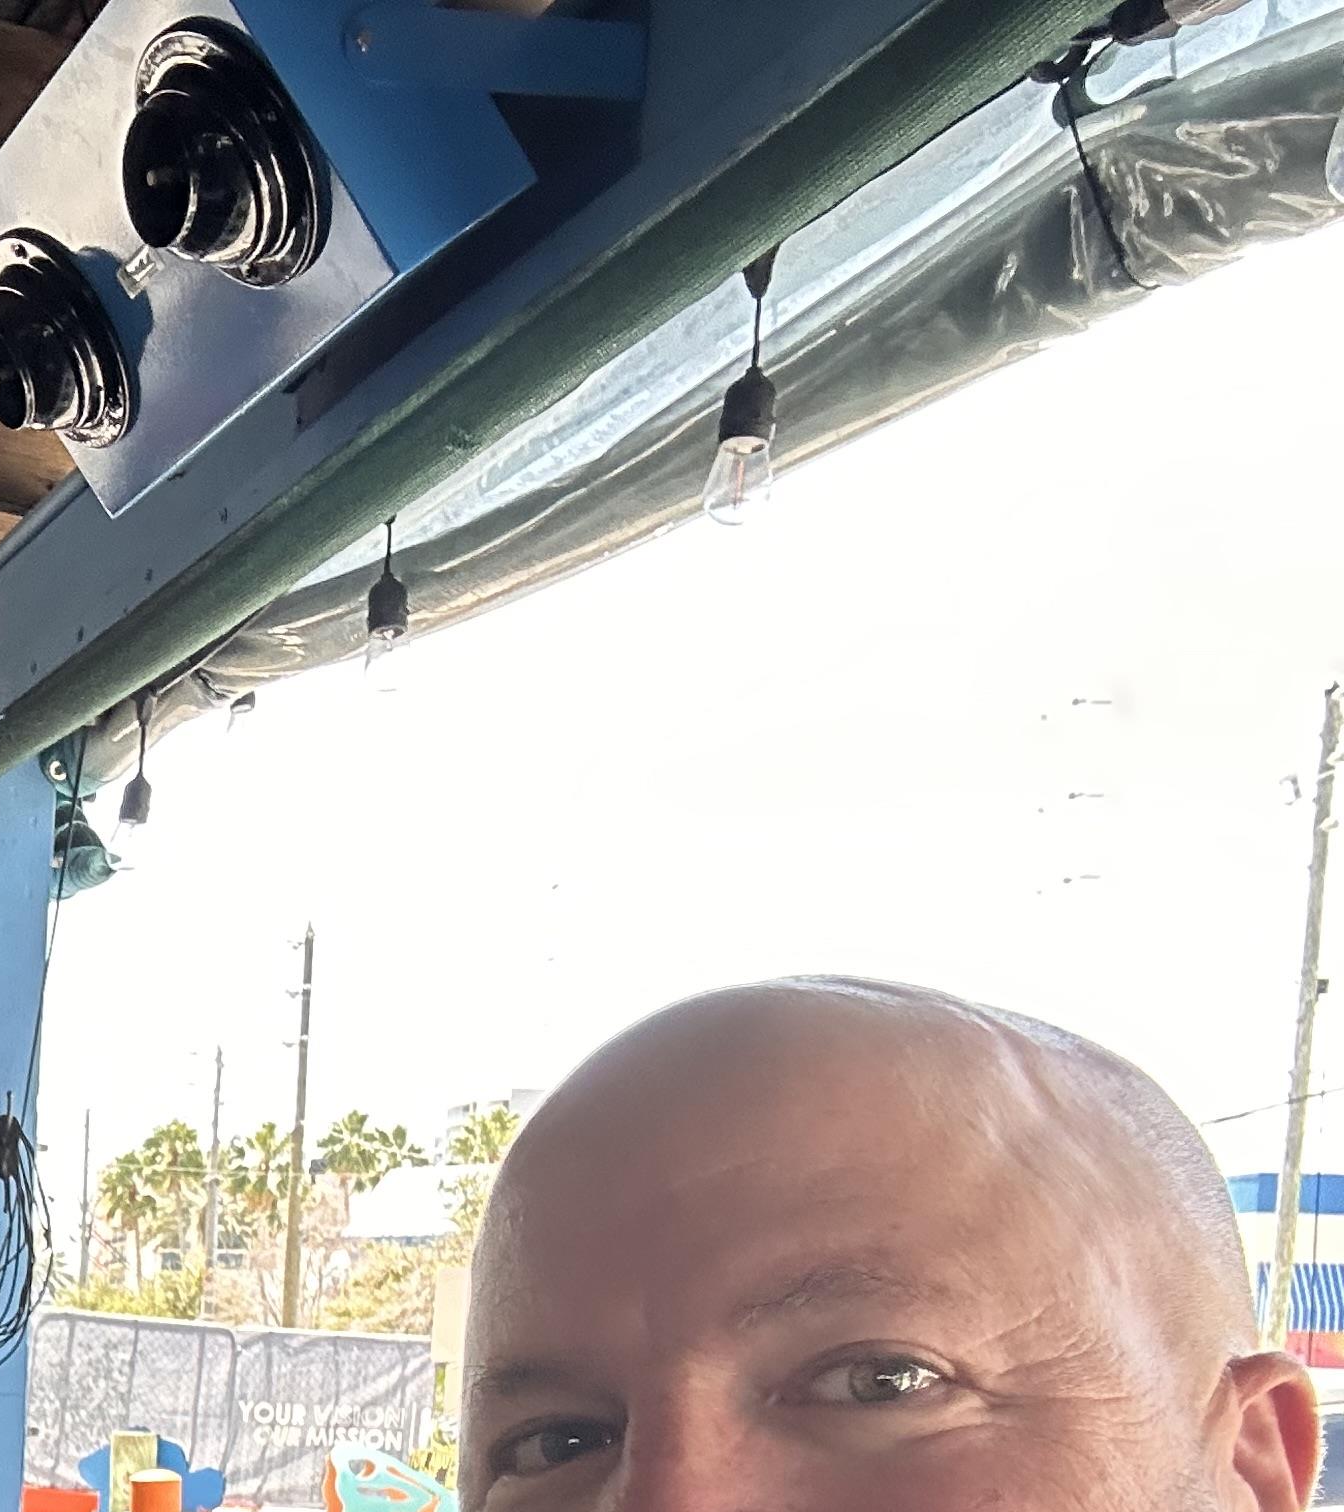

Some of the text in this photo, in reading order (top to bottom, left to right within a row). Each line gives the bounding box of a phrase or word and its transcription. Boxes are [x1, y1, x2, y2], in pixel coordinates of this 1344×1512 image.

[239, 1401, 307, 1425] YOUR
[313, 1402, 406, 1428] VISION
[253, 1425, 302, 1447] OUR
[305, 1426, 403, 1451] MISSION
